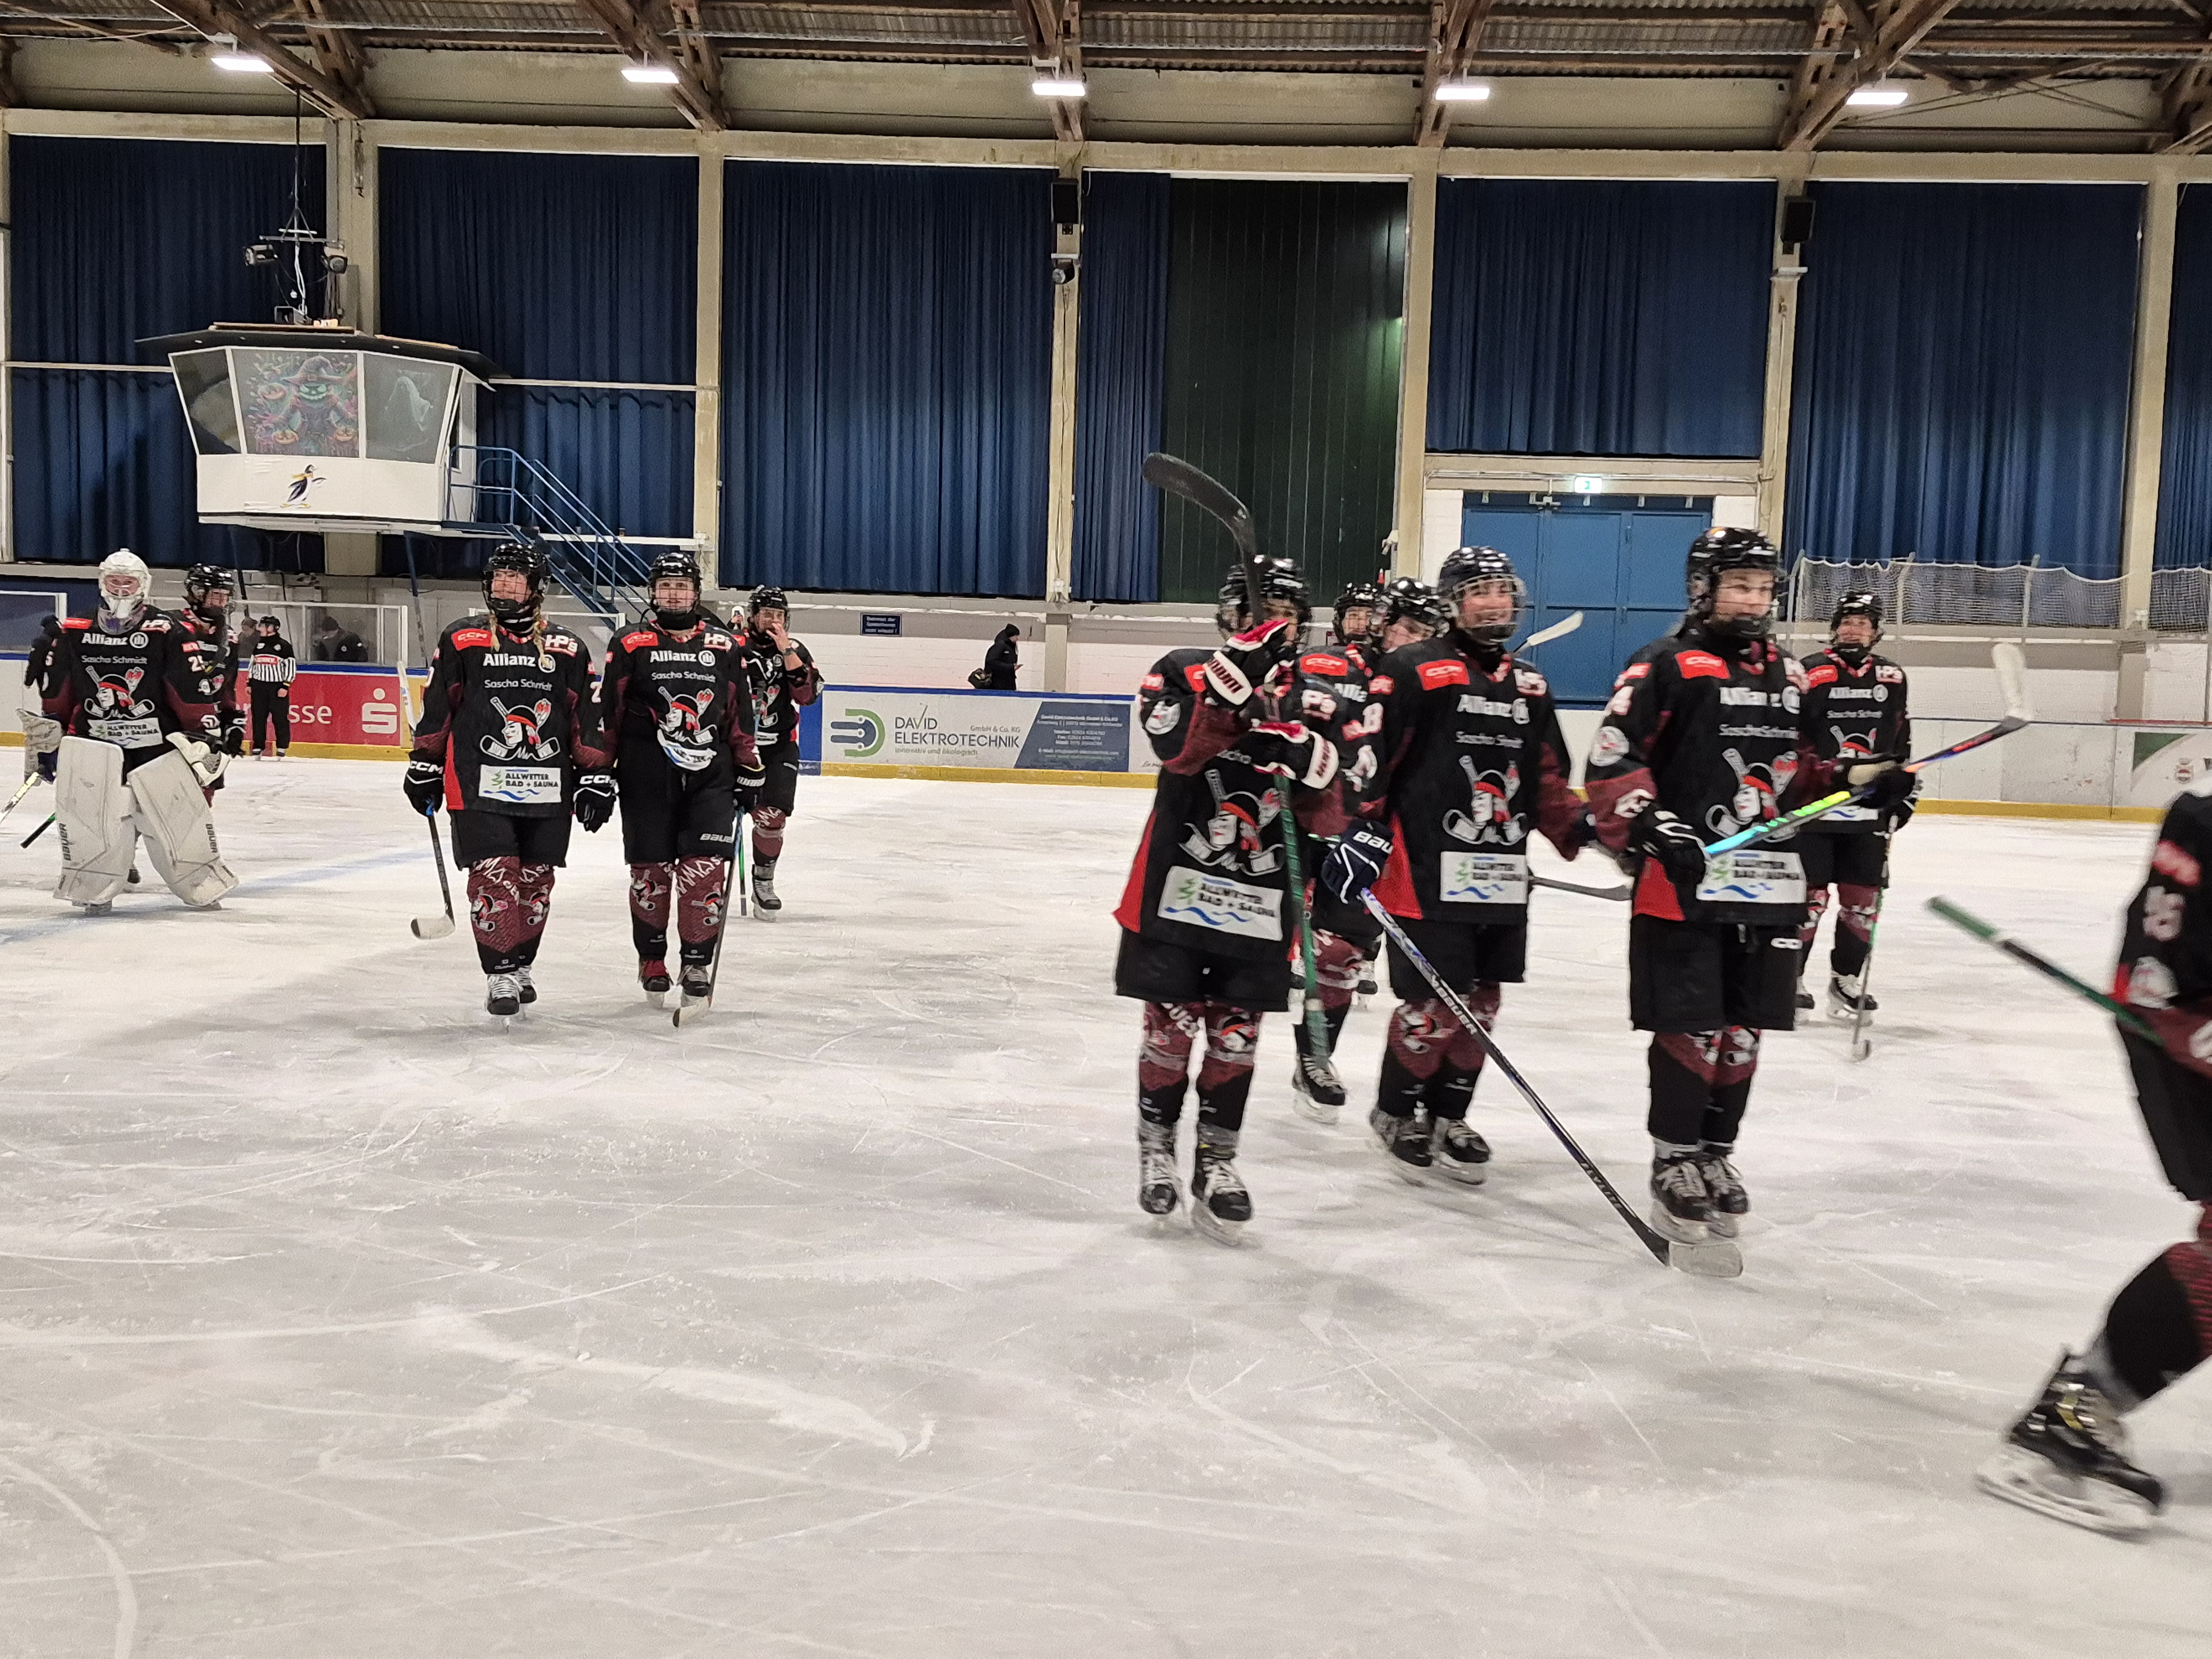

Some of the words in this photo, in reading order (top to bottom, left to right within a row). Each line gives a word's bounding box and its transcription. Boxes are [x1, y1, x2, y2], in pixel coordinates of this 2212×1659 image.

[81, 633, 128, 645] Allianz
[545, 634, 578, 653] HP's
[483, 653, 536, 667] Allianz
[650, 650, 697, 663] Allianz
[651, 671, 683, 681] Sascha
[484, 679, 519, 688] Sascha
[895, 708, 938, 730] DAVID
[895, 732, 1020, 748] ELEKTROTECHNIK
[409, 761, 444, 773] CCM
